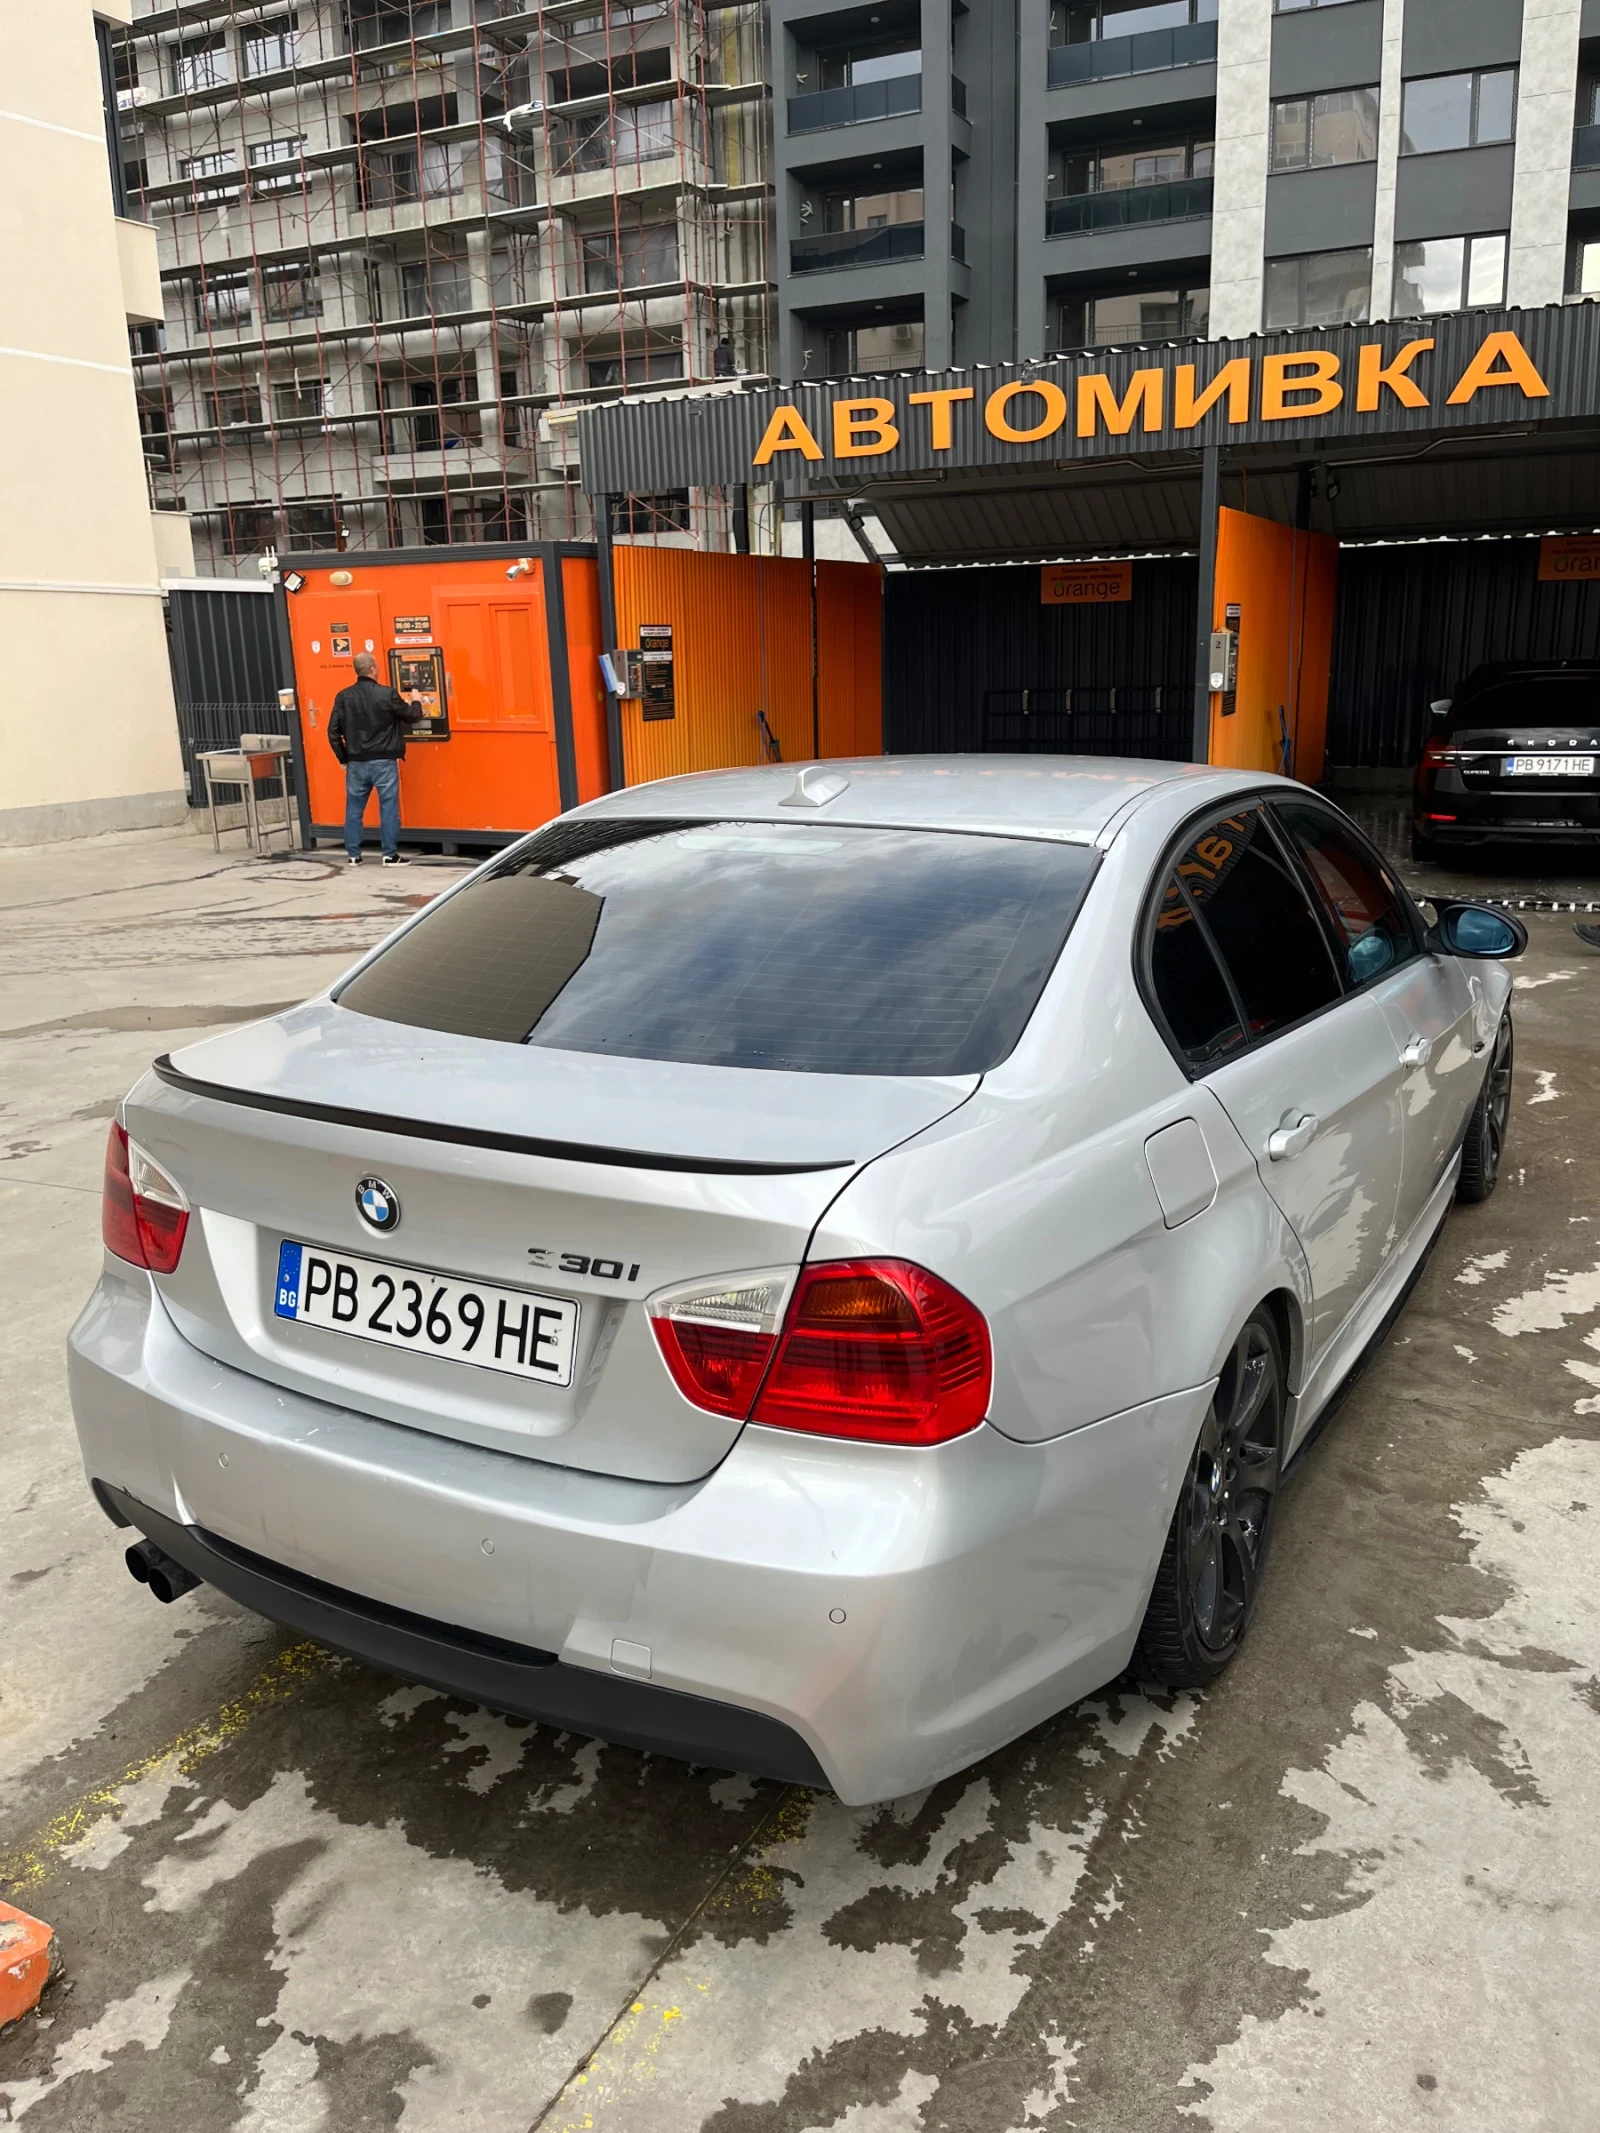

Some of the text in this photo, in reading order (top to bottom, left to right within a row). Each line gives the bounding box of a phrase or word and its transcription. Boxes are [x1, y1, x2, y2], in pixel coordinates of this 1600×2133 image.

[752, 331, 1551, 465] АВТОМИВКА
[1515, 759, 1590, 771] PB 9171 HE
[357, 1180, 392, 1199] BMW
[279, 1288, 297, 1308] BG
[304, 1257, 563, 1372] PB 2369 HE
